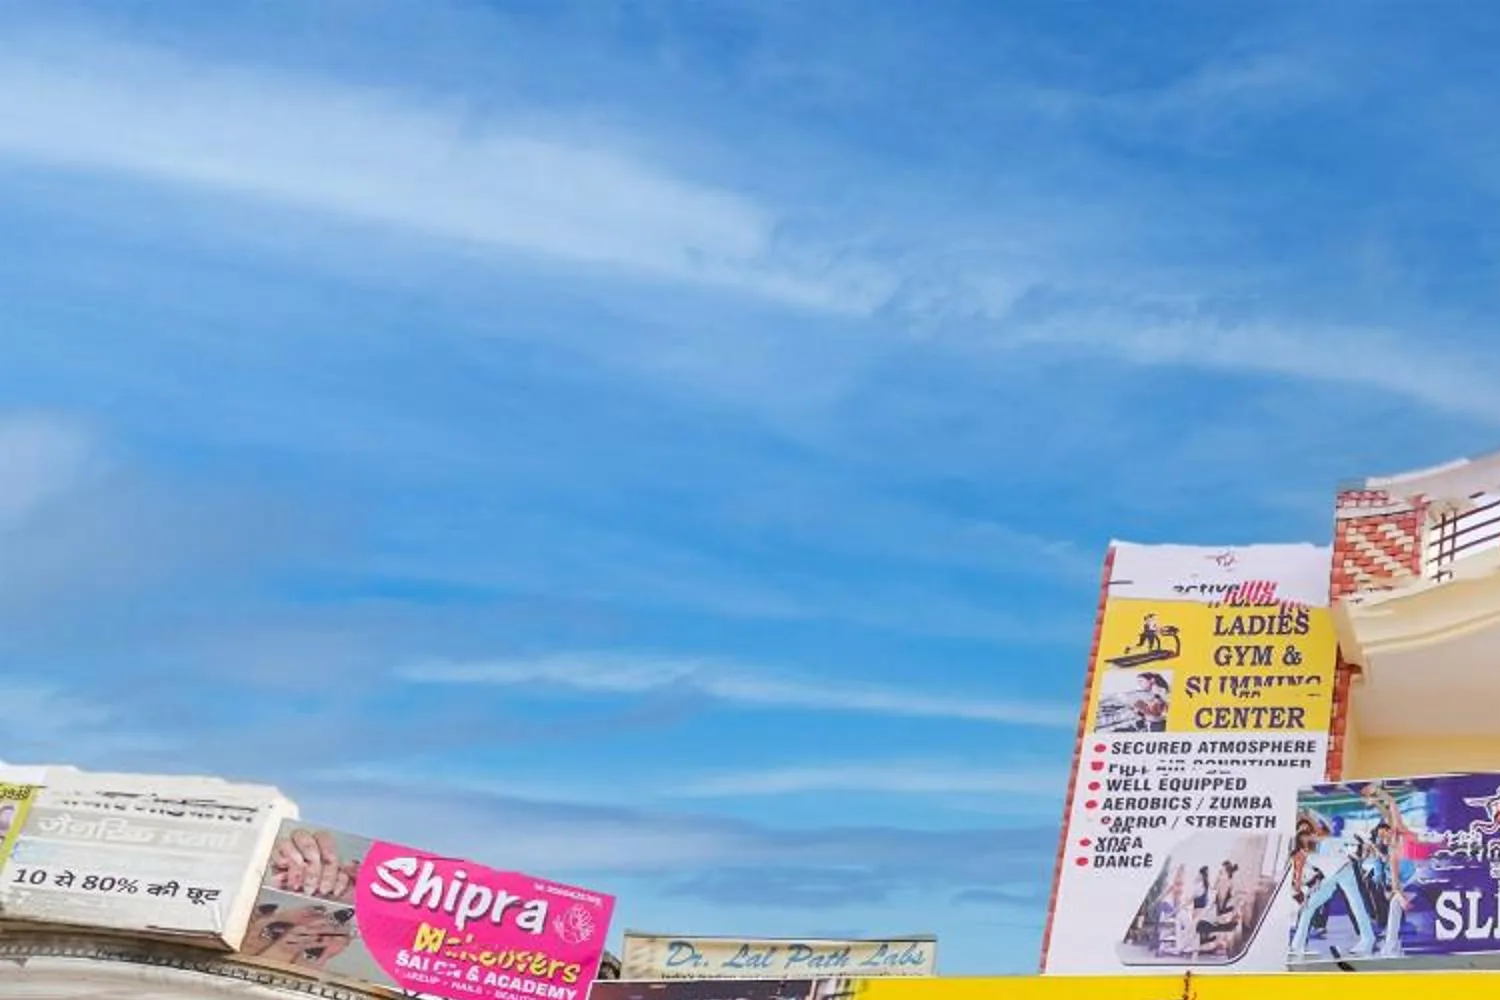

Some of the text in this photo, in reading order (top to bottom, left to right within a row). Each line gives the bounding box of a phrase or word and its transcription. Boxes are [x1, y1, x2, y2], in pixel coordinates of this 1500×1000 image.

[1213, 613, 1310, 636] LADIES
[1213, 645, 1302, 666] GYM &
[1194, 707, 1305, 729] CENTER
[1111, 740, 1317, 755] SECURED ATMOSPHERE
[1106, 777, 1247, 792] WELL EQUIPPED
[1101, 796, 1272, 811] AEROBICS ZUMBA
[1185, 815, 1276, 829] STRENGTH
[1093, 854, 1153, 868] DANCE
[13, 868, 47, 886] 10
[53, 870, 76, 888] से
[81, 874, 140, 895] 80%
[147, 881, 181, 899] की
[368, 857, 549, 936] Shipra
[665, 940, 927, 971] Dr. Lal Path Labs
[466, 966, 480, 982] &
